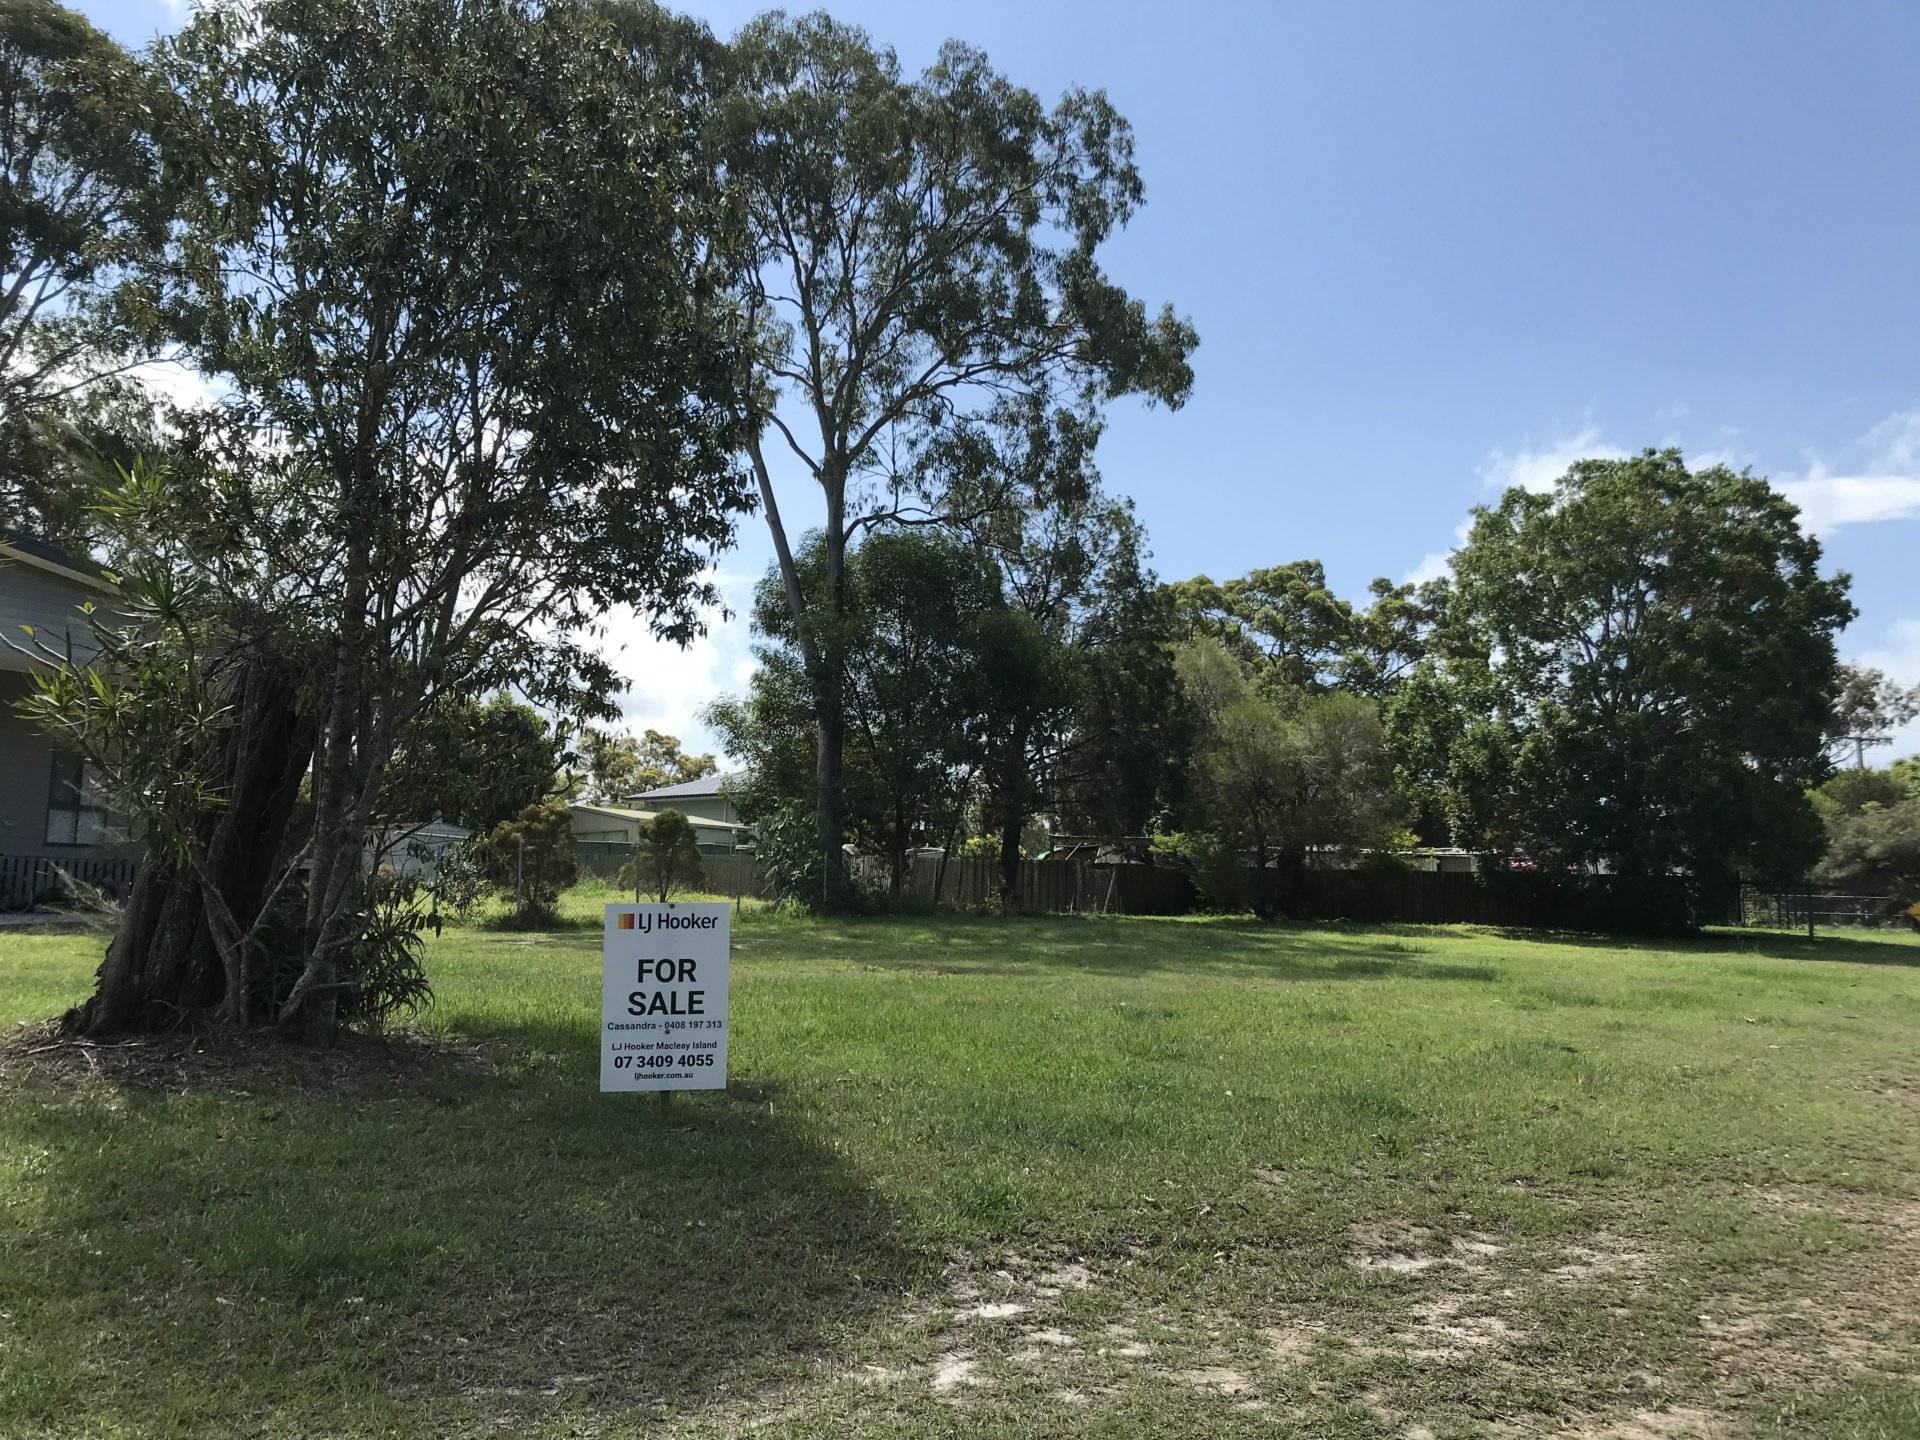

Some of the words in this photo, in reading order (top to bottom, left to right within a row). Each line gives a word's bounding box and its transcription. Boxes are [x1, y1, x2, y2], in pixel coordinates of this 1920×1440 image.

[638, 913, 652, 934] LJ
[657, 912, 718, 929] Hooker
[637, 958, 697, 983] FOR
[627, 990, 705, 1015] SALE
[607, 1022, 656, 1031] Cassandra
[664, 1021, 686, 1029] 0408
[688, 1021, 704, 1029] 197
[706, 1020, 722, 1029] 313
[611, 1043, 622, 1051] LJ
[624, 1042, 655, 1051] Hooker
[656, 1041, 691, 1051] Macleay
[692, 1041, 718, 1049] Island
[614, 1056, 632, 1069] 07
[636, 1055, 674, 1068] 3409
[677, 1054, 714, 1067] 4055
[634, 1072, 694, 1081] ljhooker.com.au
